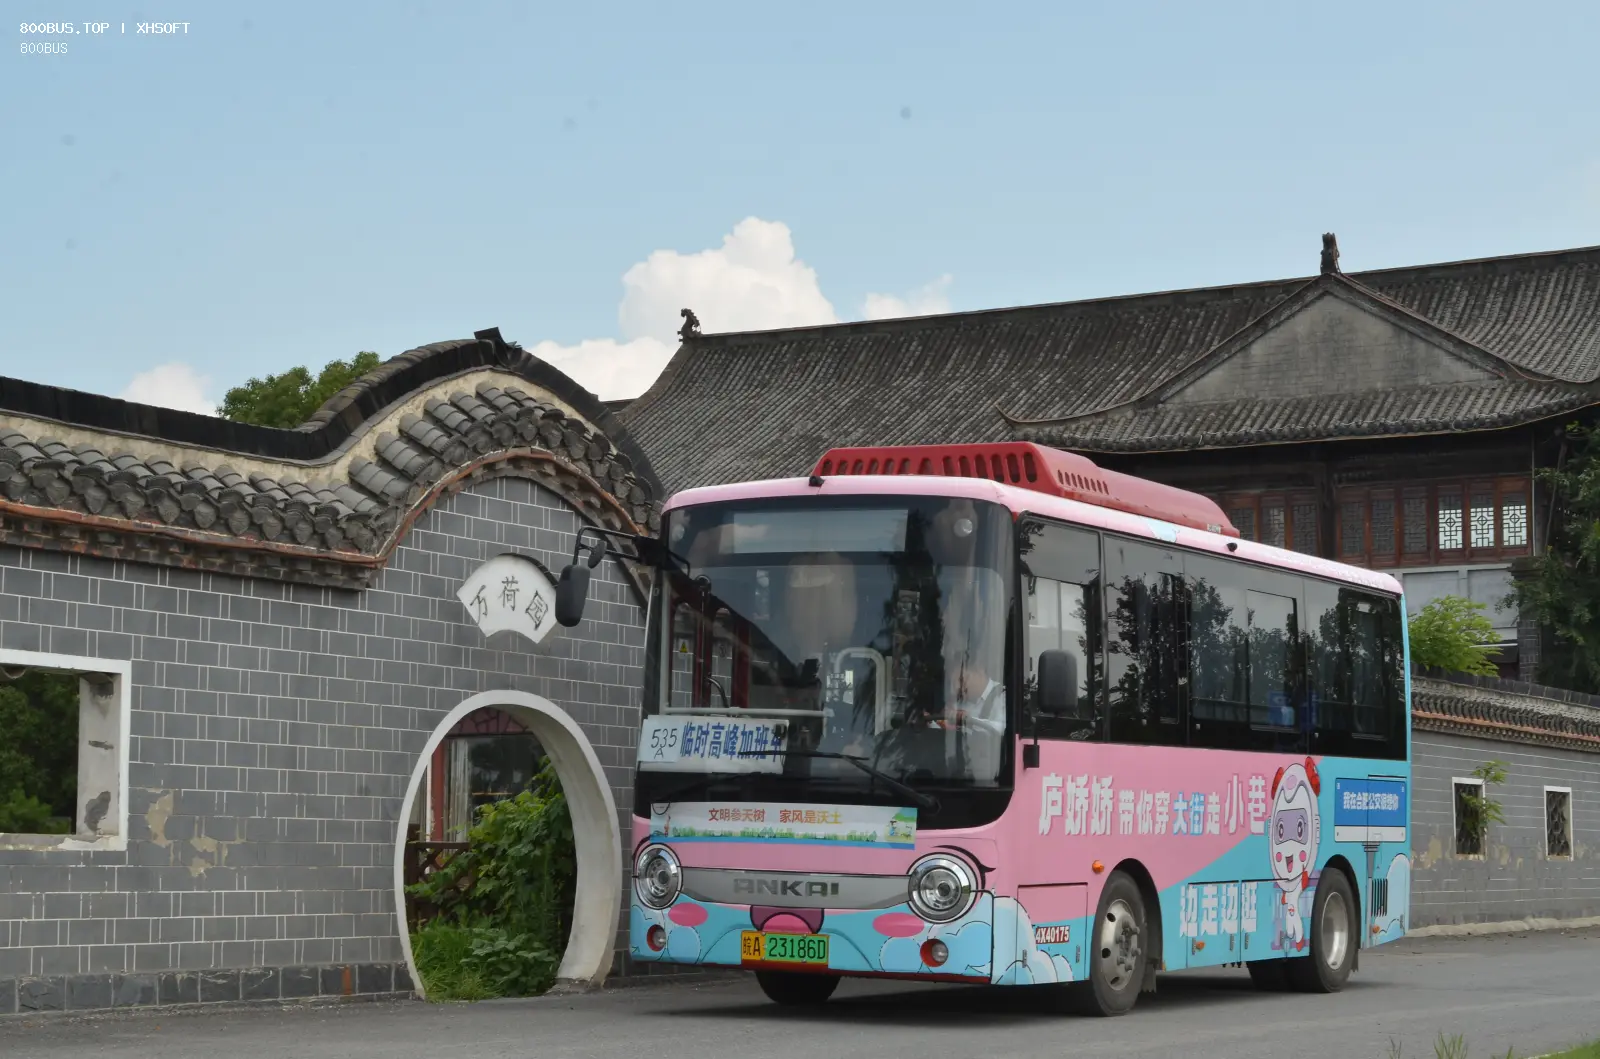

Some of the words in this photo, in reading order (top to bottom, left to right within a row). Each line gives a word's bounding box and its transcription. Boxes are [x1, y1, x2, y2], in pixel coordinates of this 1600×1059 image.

[651, 728, 678, 749] 535
[653, 747, 664, 759] A
[708, 808, 766, 823] 文明参天树
[779, 808, 842, 825] 家风是沃土
[733, 878, 840, 897] ANKAI
[1179, 882, 1258, 938] 边走边逛
[1035, 926, 1070, 943] 4X40175
